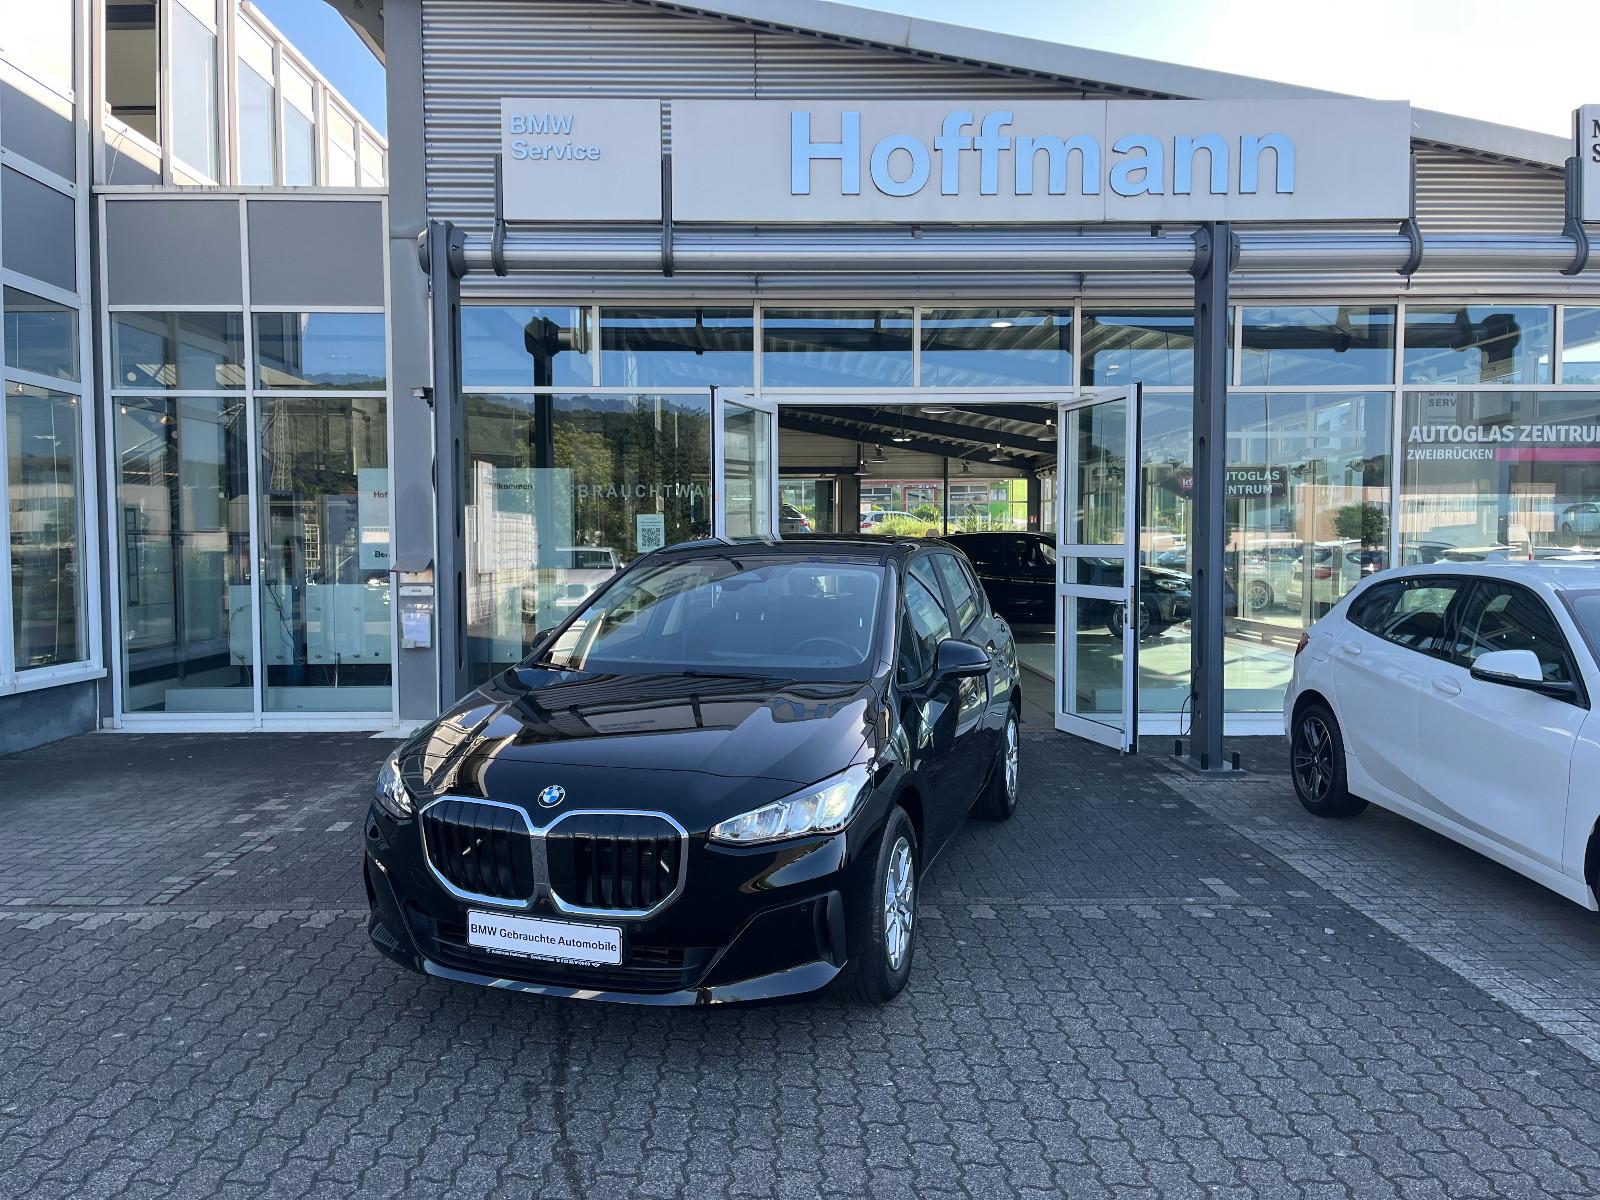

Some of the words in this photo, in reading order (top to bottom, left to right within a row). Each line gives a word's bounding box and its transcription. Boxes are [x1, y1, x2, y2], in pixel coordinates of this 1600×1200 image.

[510, 112, 573, 135] BMW
[511, 139, 601, 161] Service
[790, 111, 1296, 198] Hoffmann
[1407, 424, 1515, 443] AUTOGLAS
[1519, 425, 1600, 443] ZENTRU
[1406, 446, 1493, 461] ZWEIBRÜCKEN
[1225, 484, 1273, 495] NTRUM
[470, 923, 497, 937] BMW
[499, 928, 557, 945] Gebrauchte
[558, 936, 617, 952] Automobile
